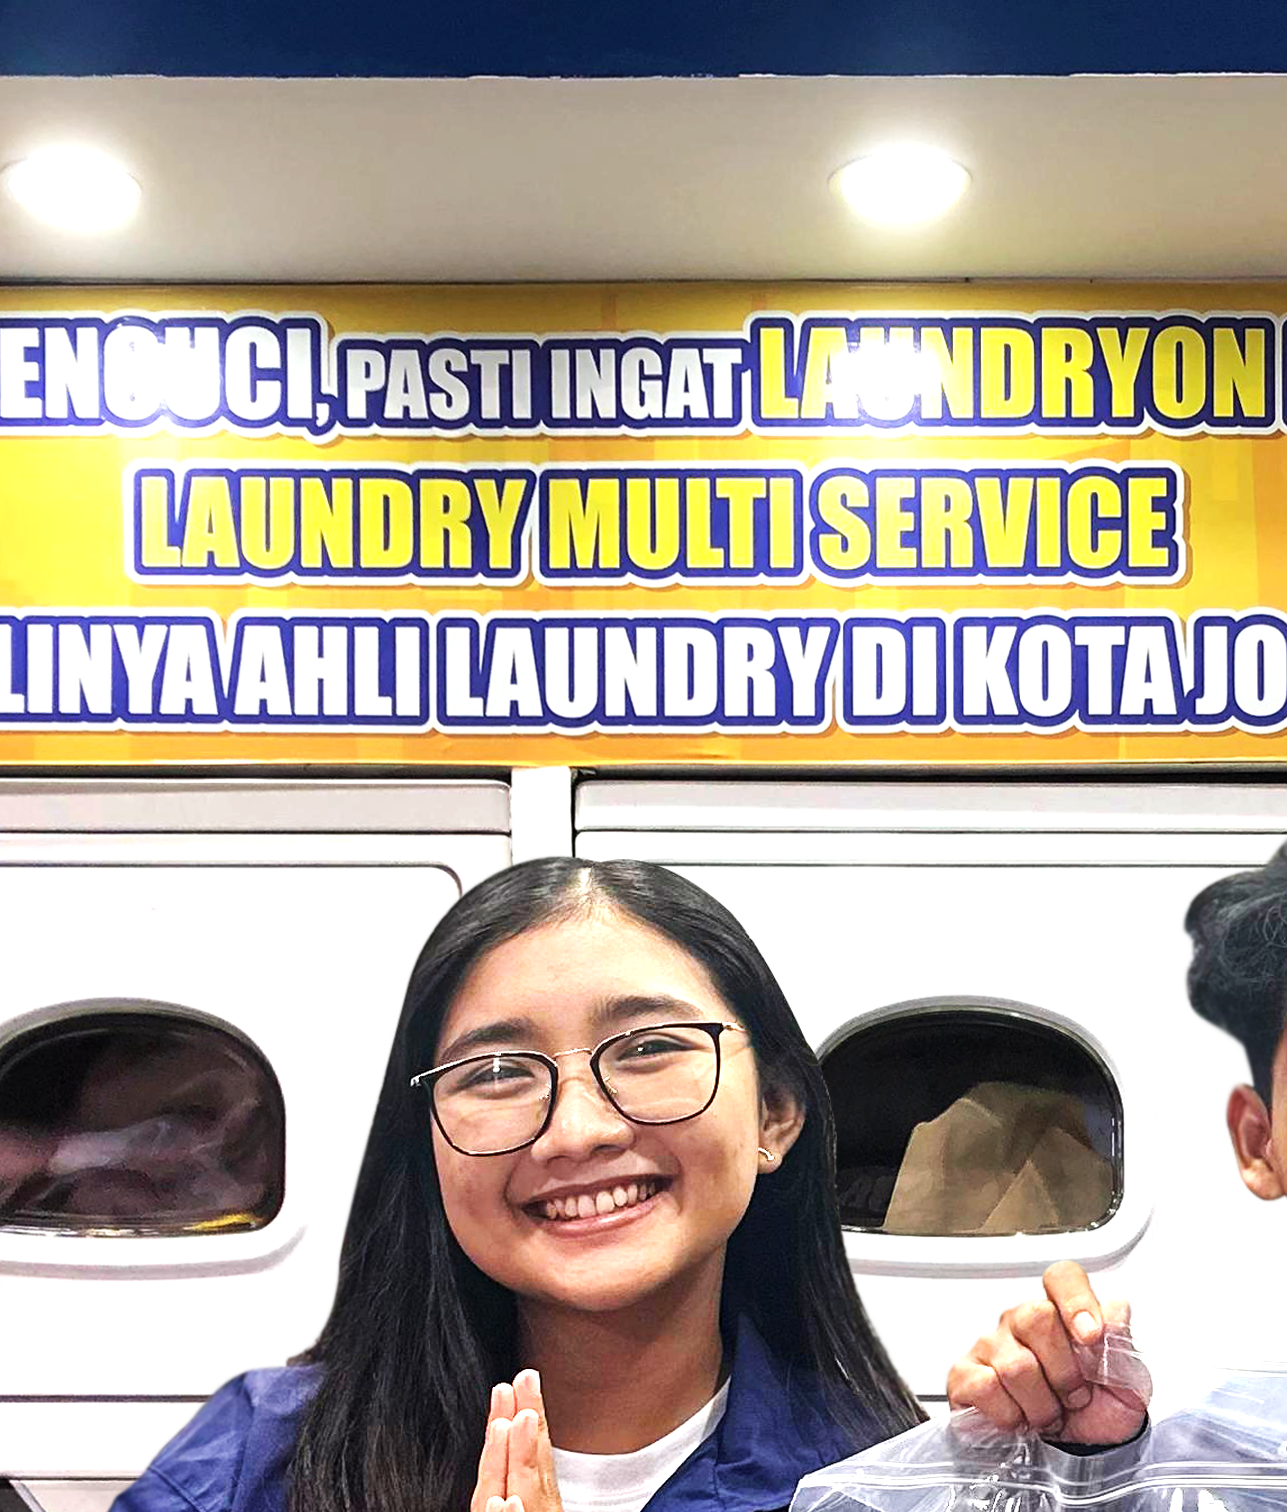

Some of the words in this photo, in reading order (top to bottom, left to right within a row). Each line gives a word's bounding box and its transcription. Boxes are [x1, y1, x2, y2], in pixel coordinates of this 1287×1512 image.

[349, 347, 542, 421] PASTI
[551, 347, 742, 421] INGAT
[759, 326, 1264, 420] LAUNDRYON
[138, 476, 532, 569] LAUNDRY
[547, 476, 793, 569] MULTI
[817, 475, 1171, 570] SERVICE
[231, 623, 423, 717] AHLI
[441, 623, 838, 717] LAUNDRY
[848, 624, 938, 716] DI
[965, 622, 1183, 717] KOTA
